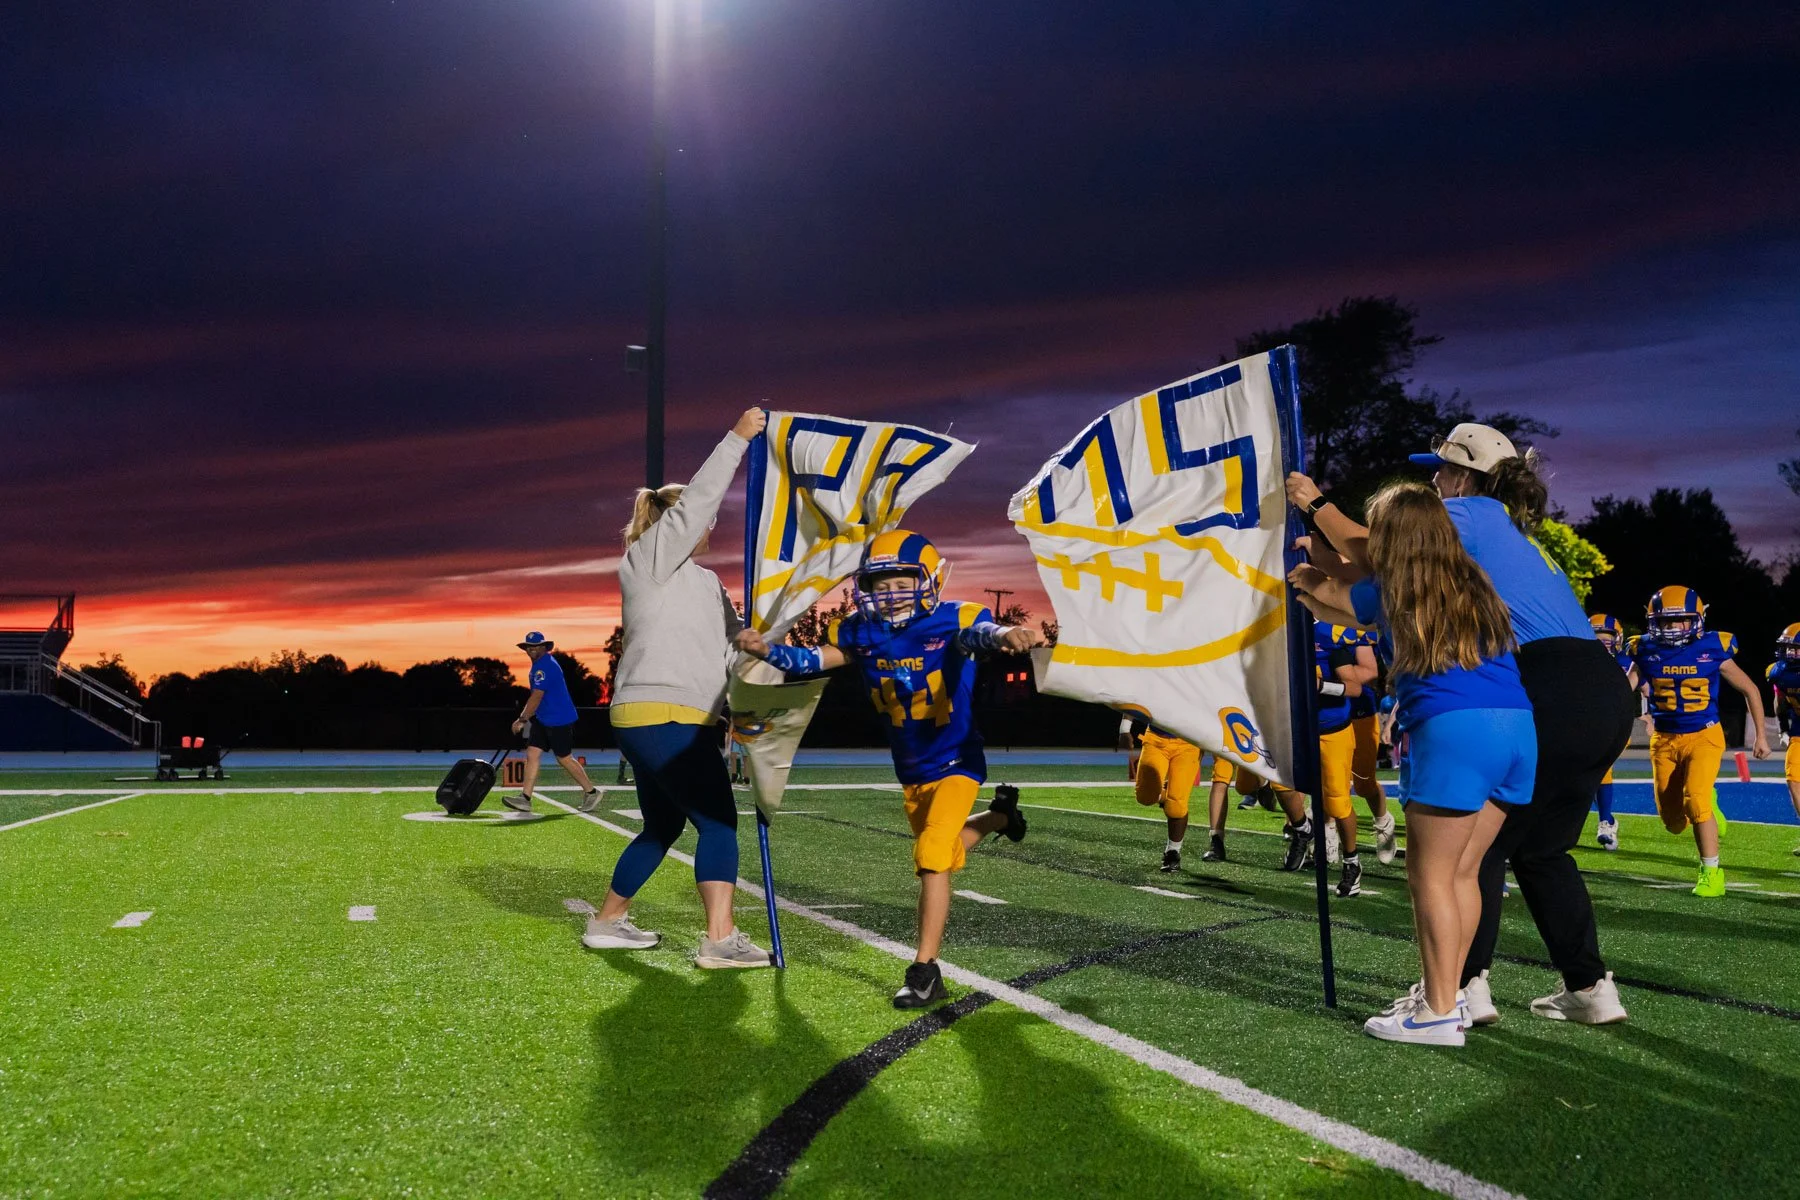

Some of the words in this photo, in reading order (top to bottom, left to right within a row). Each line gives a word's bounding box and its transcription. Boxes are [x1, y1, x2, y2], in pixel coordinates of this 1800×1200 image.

[764, 416, 953, 563] RA
[876, 657, 924, 671] RAMS
[1662, 665, 1698, 675] RAMS
[870, 669, 953, 727] 44
[1652, 678, 1711, 713] 59
[505, 761, 525, 783] 10
